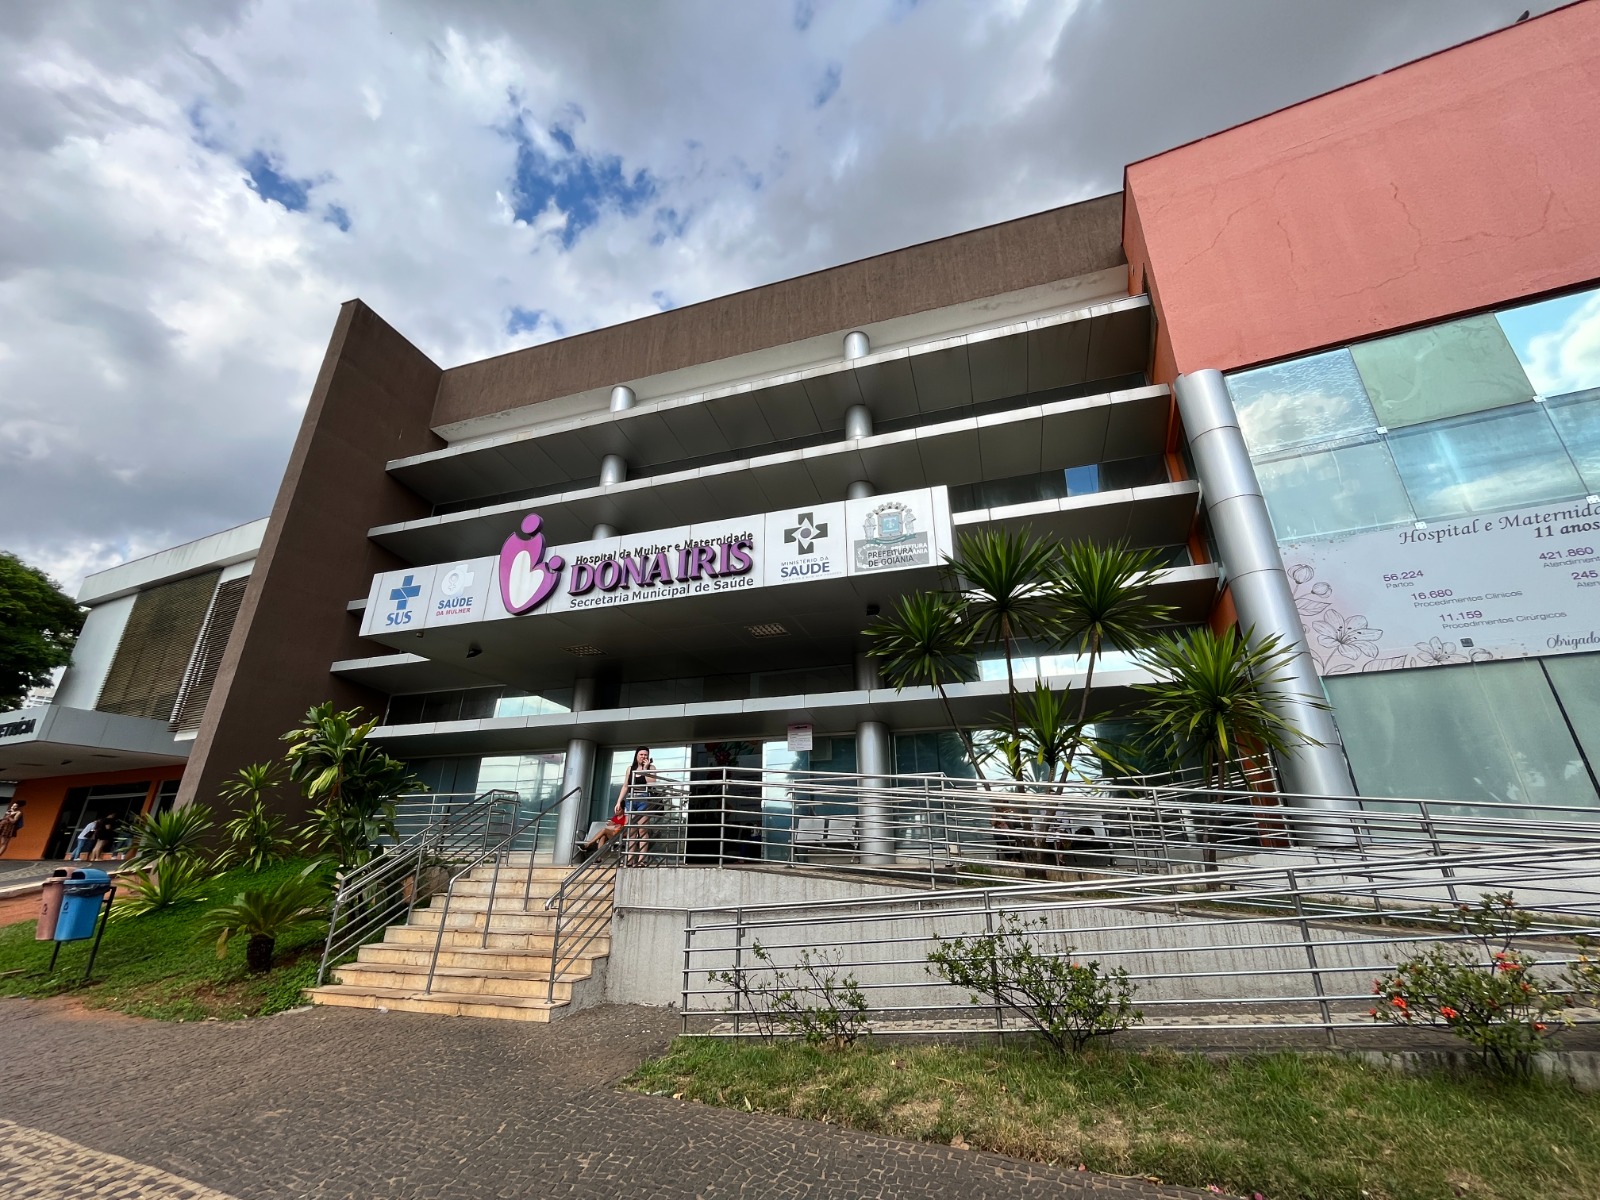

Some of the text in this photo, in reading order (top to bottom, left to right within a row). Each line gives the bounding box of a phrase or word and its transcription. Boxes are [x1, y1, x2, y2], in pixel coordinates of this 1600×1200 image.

[1399, 518, 1480, 545] Hospital
[1484, 521, 1493, 532] e
[1534, 520, 1600, 539] 11 anos
[575, 530, 754, 566] Hospital da Mulher e Maternidade
[1539, 546, 1594, 561] 421.860
[567, 538, 754, 597] DONA IRIS
[1383, 569, 1424, 582] 56.224
[1385, 581, 1414, 589] Partos
[569, 576, 754, 609] Secretaria Municipal de Saúde
[1411, 588, 1453, 601] 16.680
[437, 596, 474, 610] SAÚDE
[1413, 595, 1484, 608] Procedimentos
[385, 610, 413, 626] SUS
[445, 607, 471, 615] MULHER
[1439, 610, 1483, 622] 11.159
[1442, 616, 1514, 630] Procedimentos
[1546, 631, 1600, 651] Obrigado
